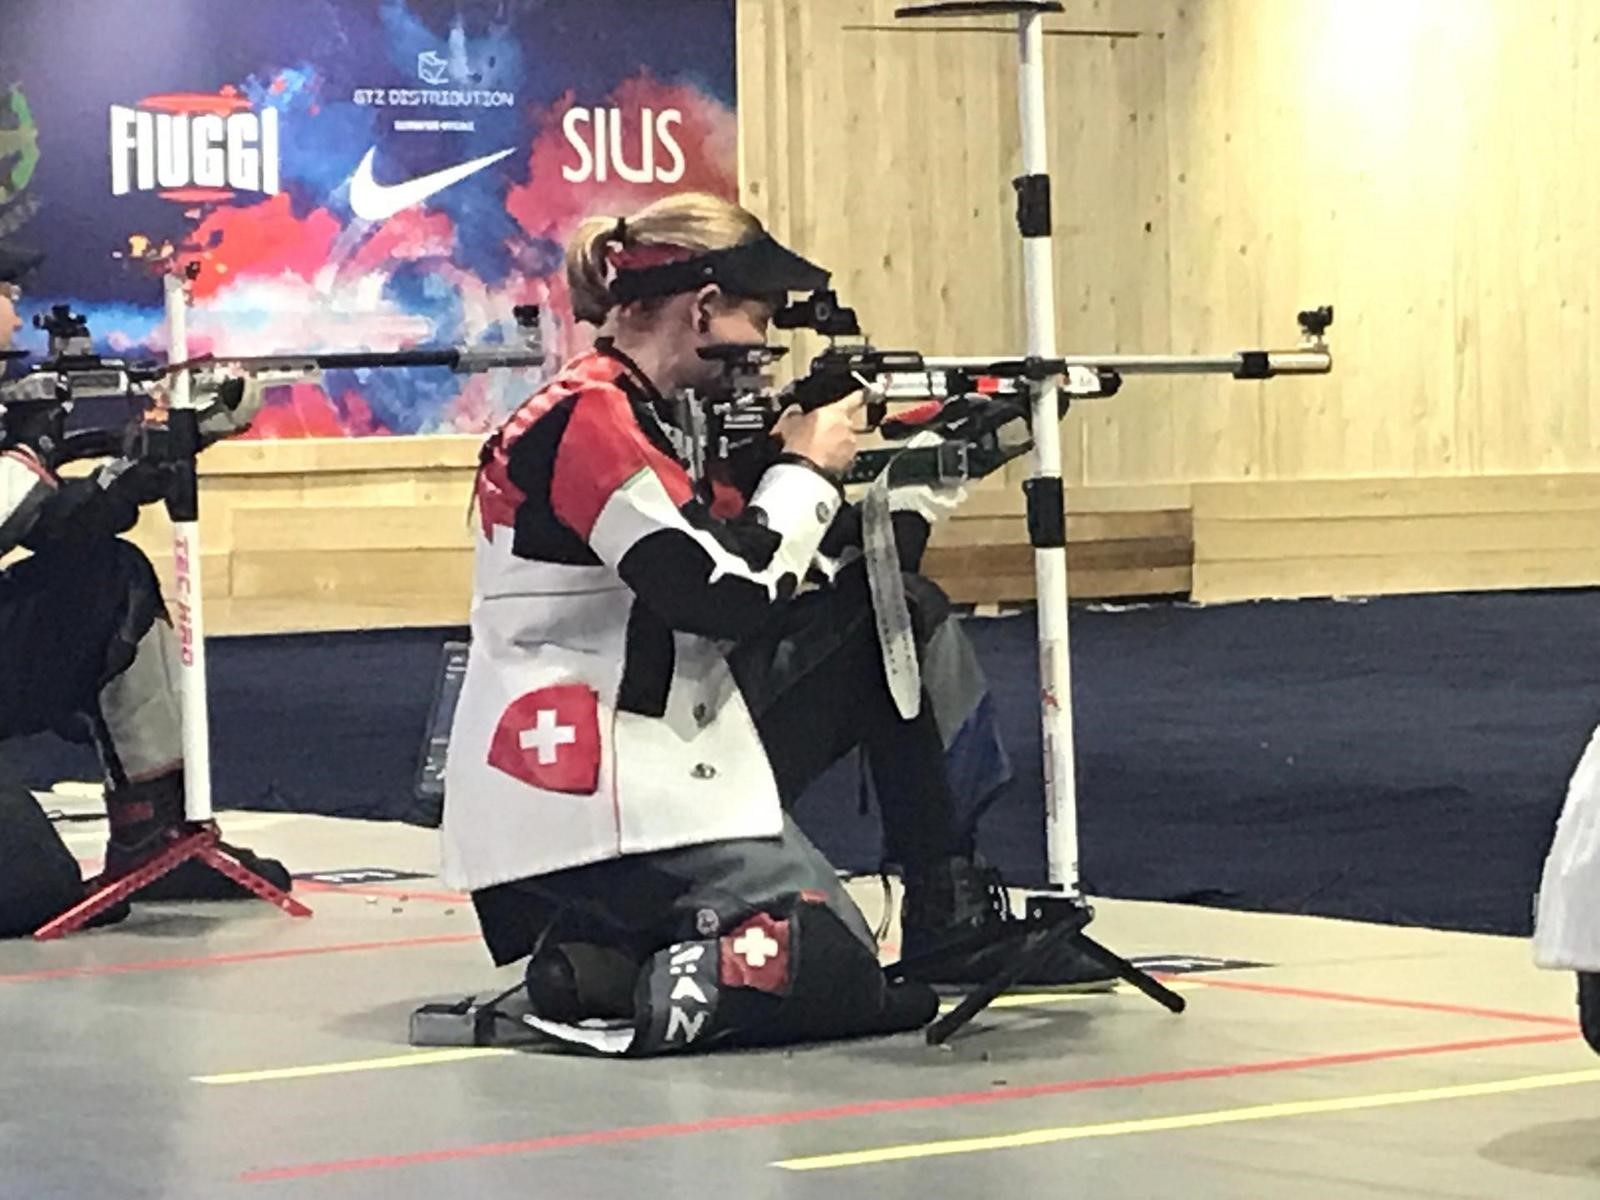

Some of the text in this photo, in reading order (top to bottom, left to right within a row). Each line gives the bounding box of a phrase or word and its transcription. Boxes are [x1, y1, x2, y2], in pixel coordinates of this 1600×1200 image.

[388, 89, 515, 107] DISTRIBUTION
[110, 104, 279, 196] FIUGGI
[562, 106, 686, 183] SIUS
